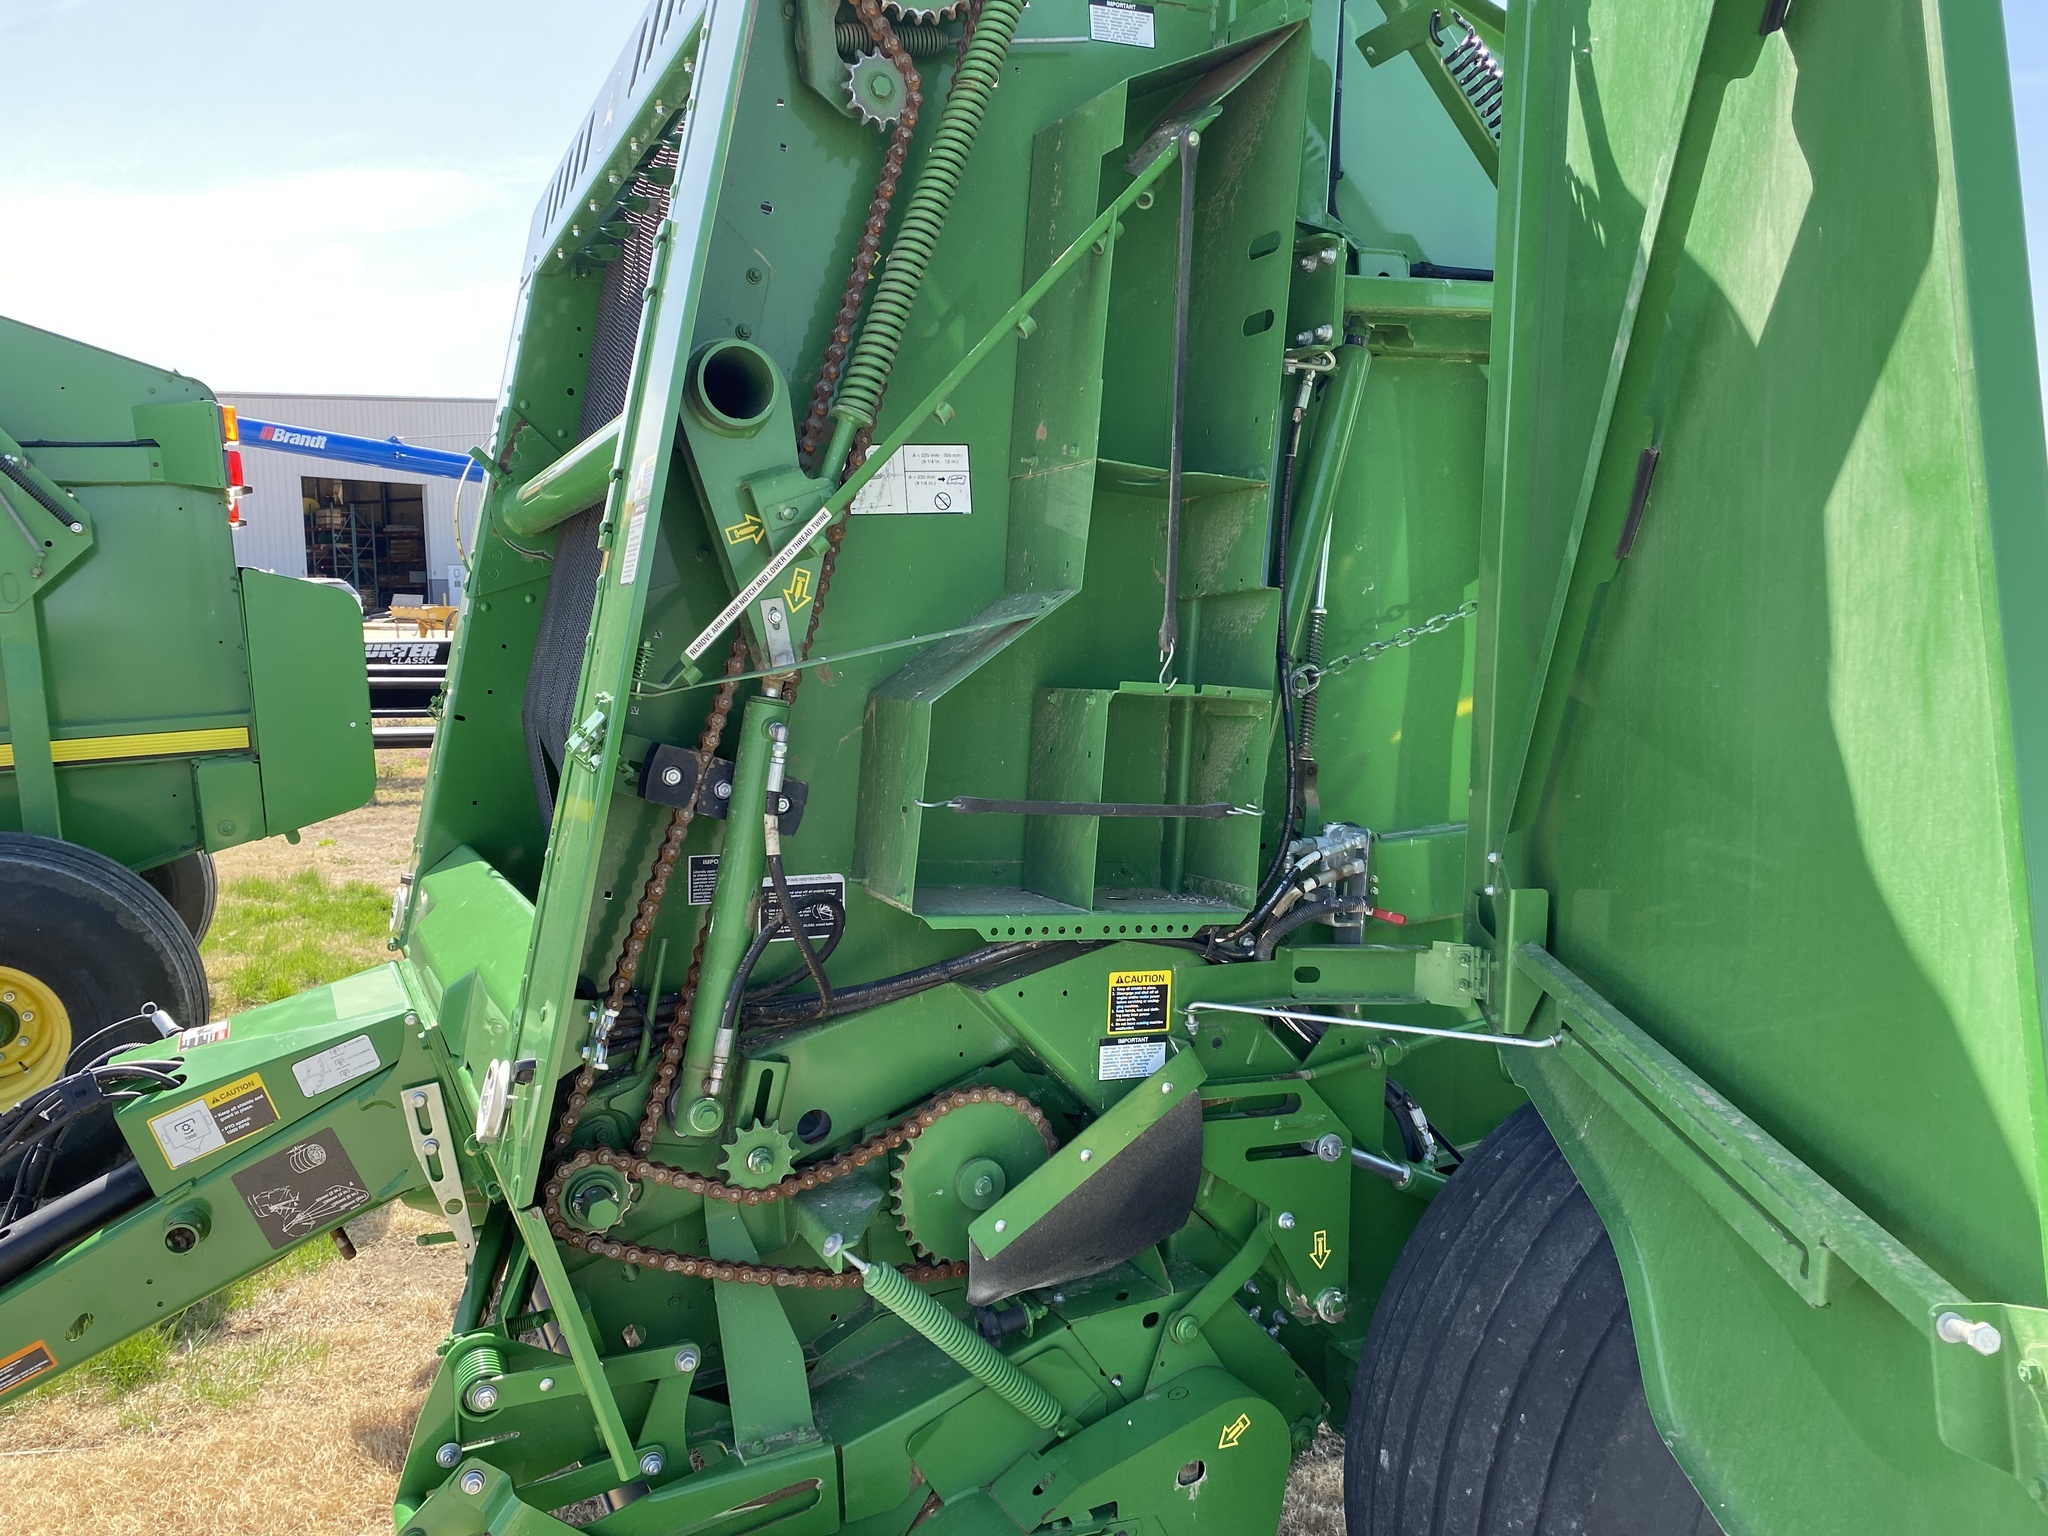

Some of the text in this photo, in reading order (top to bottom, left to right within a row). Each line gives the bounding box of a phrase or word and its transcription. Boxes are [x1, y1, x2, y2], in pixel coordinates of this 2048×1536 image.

[1107, 0, 1136, 10] IMPORTANT
[272, 428, 327, 449] Brandt
[690, 511, 829, 656] REMOVE ARM FROM NOTCH AND LOWER TO THREAD TWINE
[365, 644, 439, 658] UNTER
[1124, 975, 1165, 983] CAUTION
[220, 1081, 254, 1100] CAUTION
